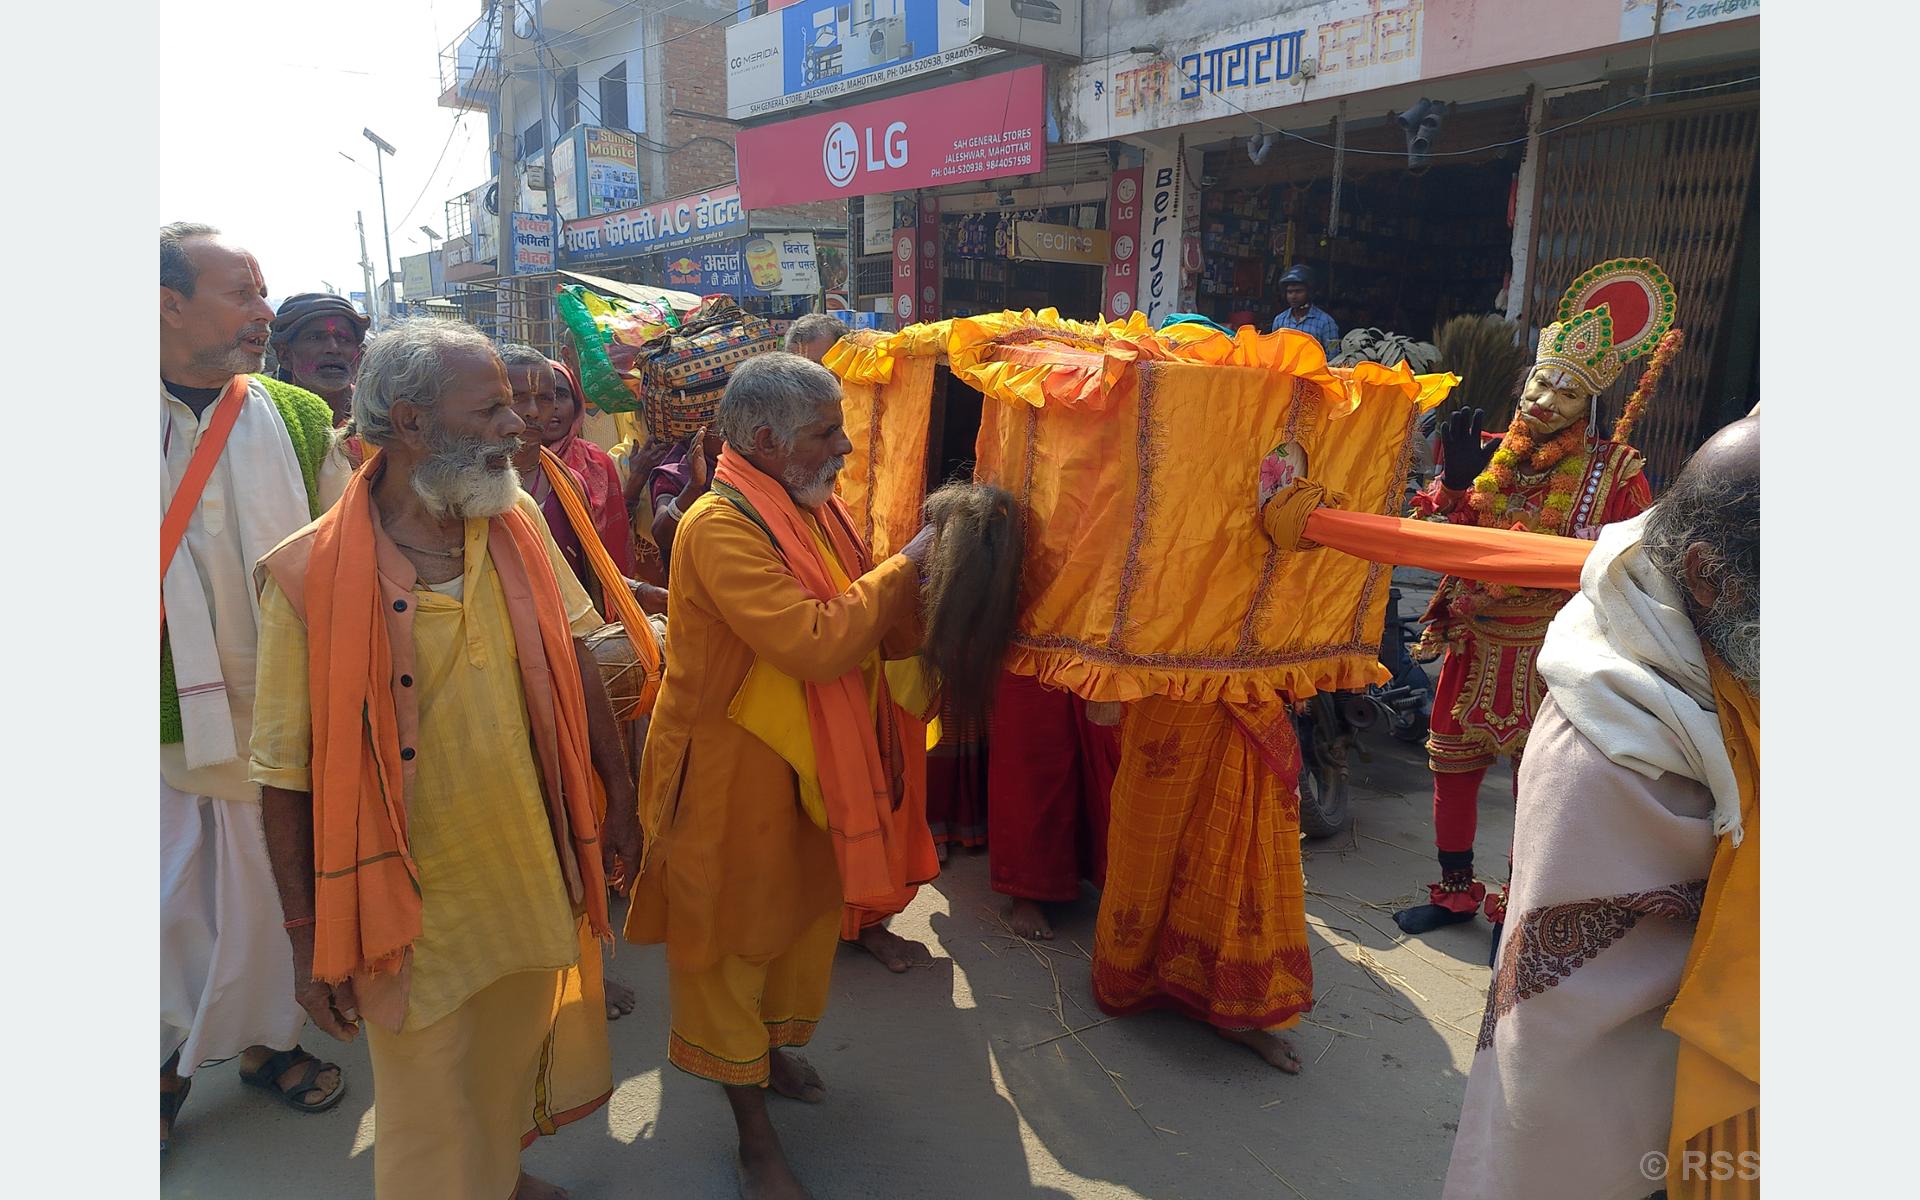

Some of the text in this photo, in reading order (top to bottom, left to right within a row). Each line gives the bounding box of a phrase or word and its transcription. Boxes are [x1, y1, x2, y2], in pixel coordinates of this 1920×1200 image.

[730, 56, 742, 70] CG
[743, 46, 779, 64] MERIDIA
[750, 104, 761, 113] SAH
[761, 96, 785, 111] GENERAL
[847, 72, 886, 89] MAHOTTARI,
[886, 68, 898, 80] PH:
[899, 55, 943, 75] 044-520938,
[590, 142, 634, 158] Mobile
[865, 121, 909, 172] LG
[953, 128, 1032, 150] SAH GENERAL STORES
[945, 141, 1032, 164] JALESHWAR, MAHOTTARI
[931, 154, 1031, 178] PH: 044-520938, 9844057598
[658, 203, 691, 238] AC
[695, 193, 746, 230] होटल
[924, 215, 935, 224] LG
[1118, 207, 1133, 220] LG
[1036, 231, 1093, 254] realme
[1149, 167, 1173, 319] Berger
[898, 265, 911, 277] LG
[924, 260, 935, 270] LG
[1115, 263, 1131, 277] LG
[924, 304, 935, 314] LG
